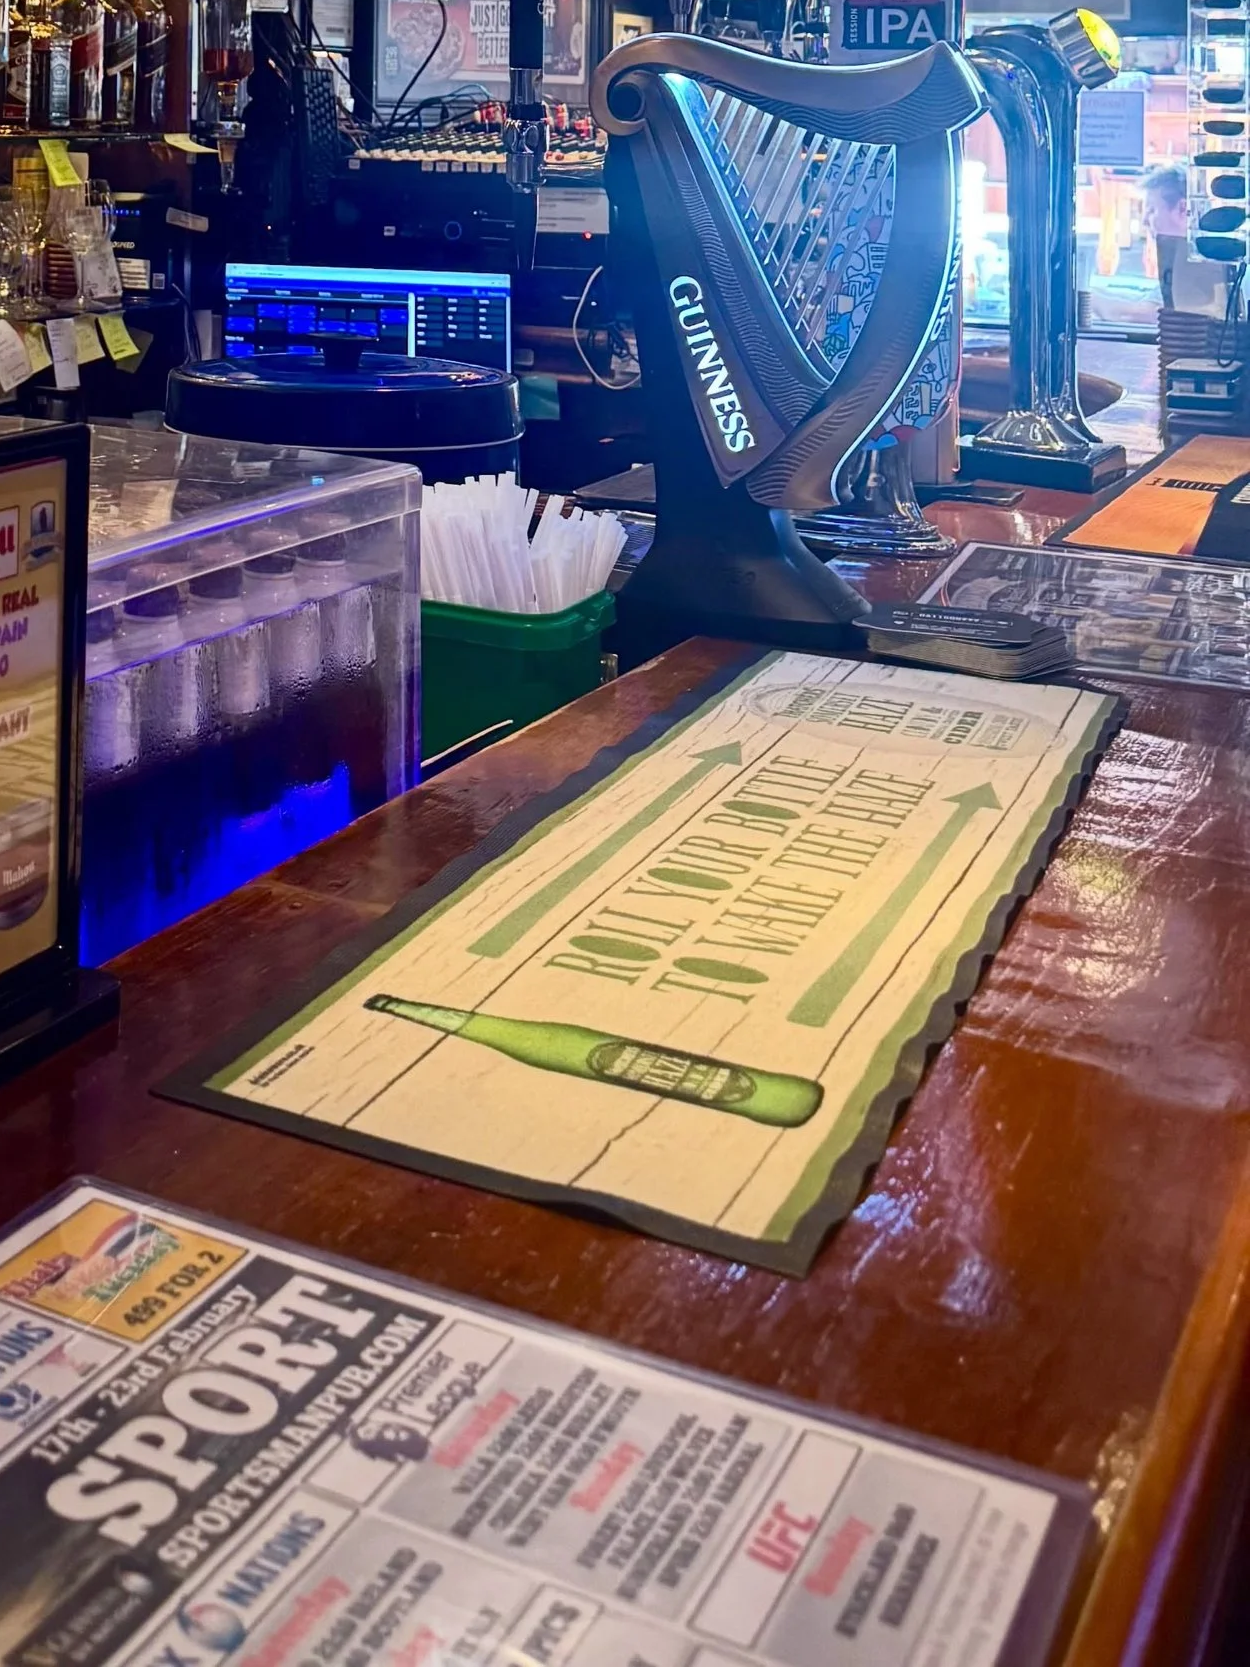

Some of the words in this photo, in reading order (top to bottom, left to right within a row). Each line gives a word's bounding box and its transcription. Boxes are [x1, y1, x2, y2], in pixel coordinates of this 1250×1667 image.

[471, 2, 497, 27] JUST
[850, 8, 858, 44] SESSION
[866, 8, 938, 44] IPA
[669, 275, 755, 452] GUINNESS
[2, 585, 39, 615] REAL
[837, 696, 915, 734] HAZE
[943, 710, 985, 745] CIDER
[816, 768, 938, 830] HAZE
[3, 861, 36, 887] Mahou
[543, 906, 697, 986] ROLL
[623, 835, 771, 905] YOUR
[703, 755, 852, 838] BOTTLE
[770, 823, 890, 879] THE
[694, 874, 845, 956] WAKE
[651, 956, 770, 1004] TO
[157, 1267, 210, 1299] FOR
[198, 1250, 224, 1266] 2
[32, 1416, 98, 1464] 17th
[107, 1356, 165, 1408] 23rd
[148, 1284, 258, 1365] February
[382, 1351, 454, 1410] Premier
[419, 1360, 491, 1423] League
[46, 1274, 376, 1547] SPORT
[158, 1314, 429, 1568] SPORTSMANPUB.COM
[217, 1511, 325, 1608] NATIONS
[746, 1500, 818, 1574] UFC
